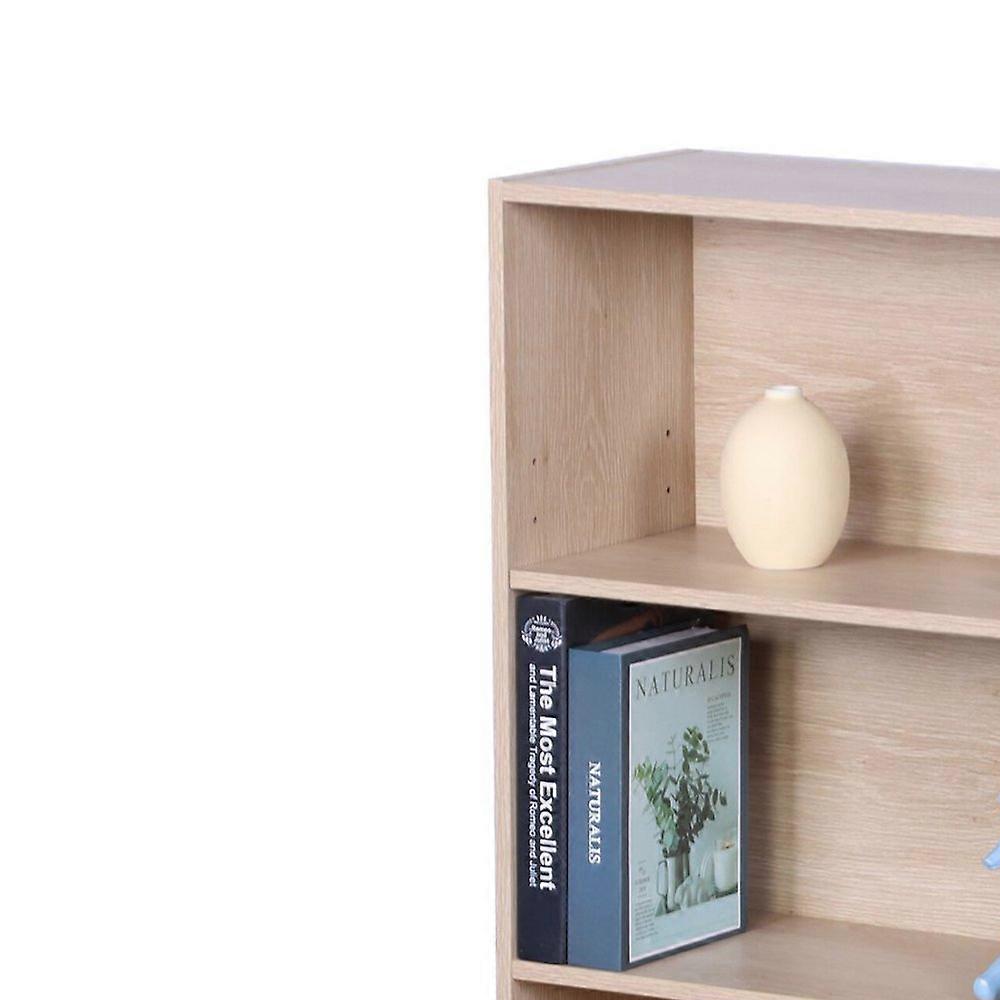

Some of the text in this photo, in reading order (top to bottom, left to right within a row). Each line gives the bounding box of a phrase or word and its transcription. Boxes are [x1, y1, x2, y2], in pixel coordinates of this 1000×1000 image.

[540, 665, 557, 710] The
[635, 653, 736, 700] NATURALIS
[527, 663, 539, 887] and Lamentable Tragedy of Romeo and Juliet
[540, 716, 557, 776] Most
[540, 780, 557, 892] Excellent
[588, 761, 601, 864] NATURALIS
